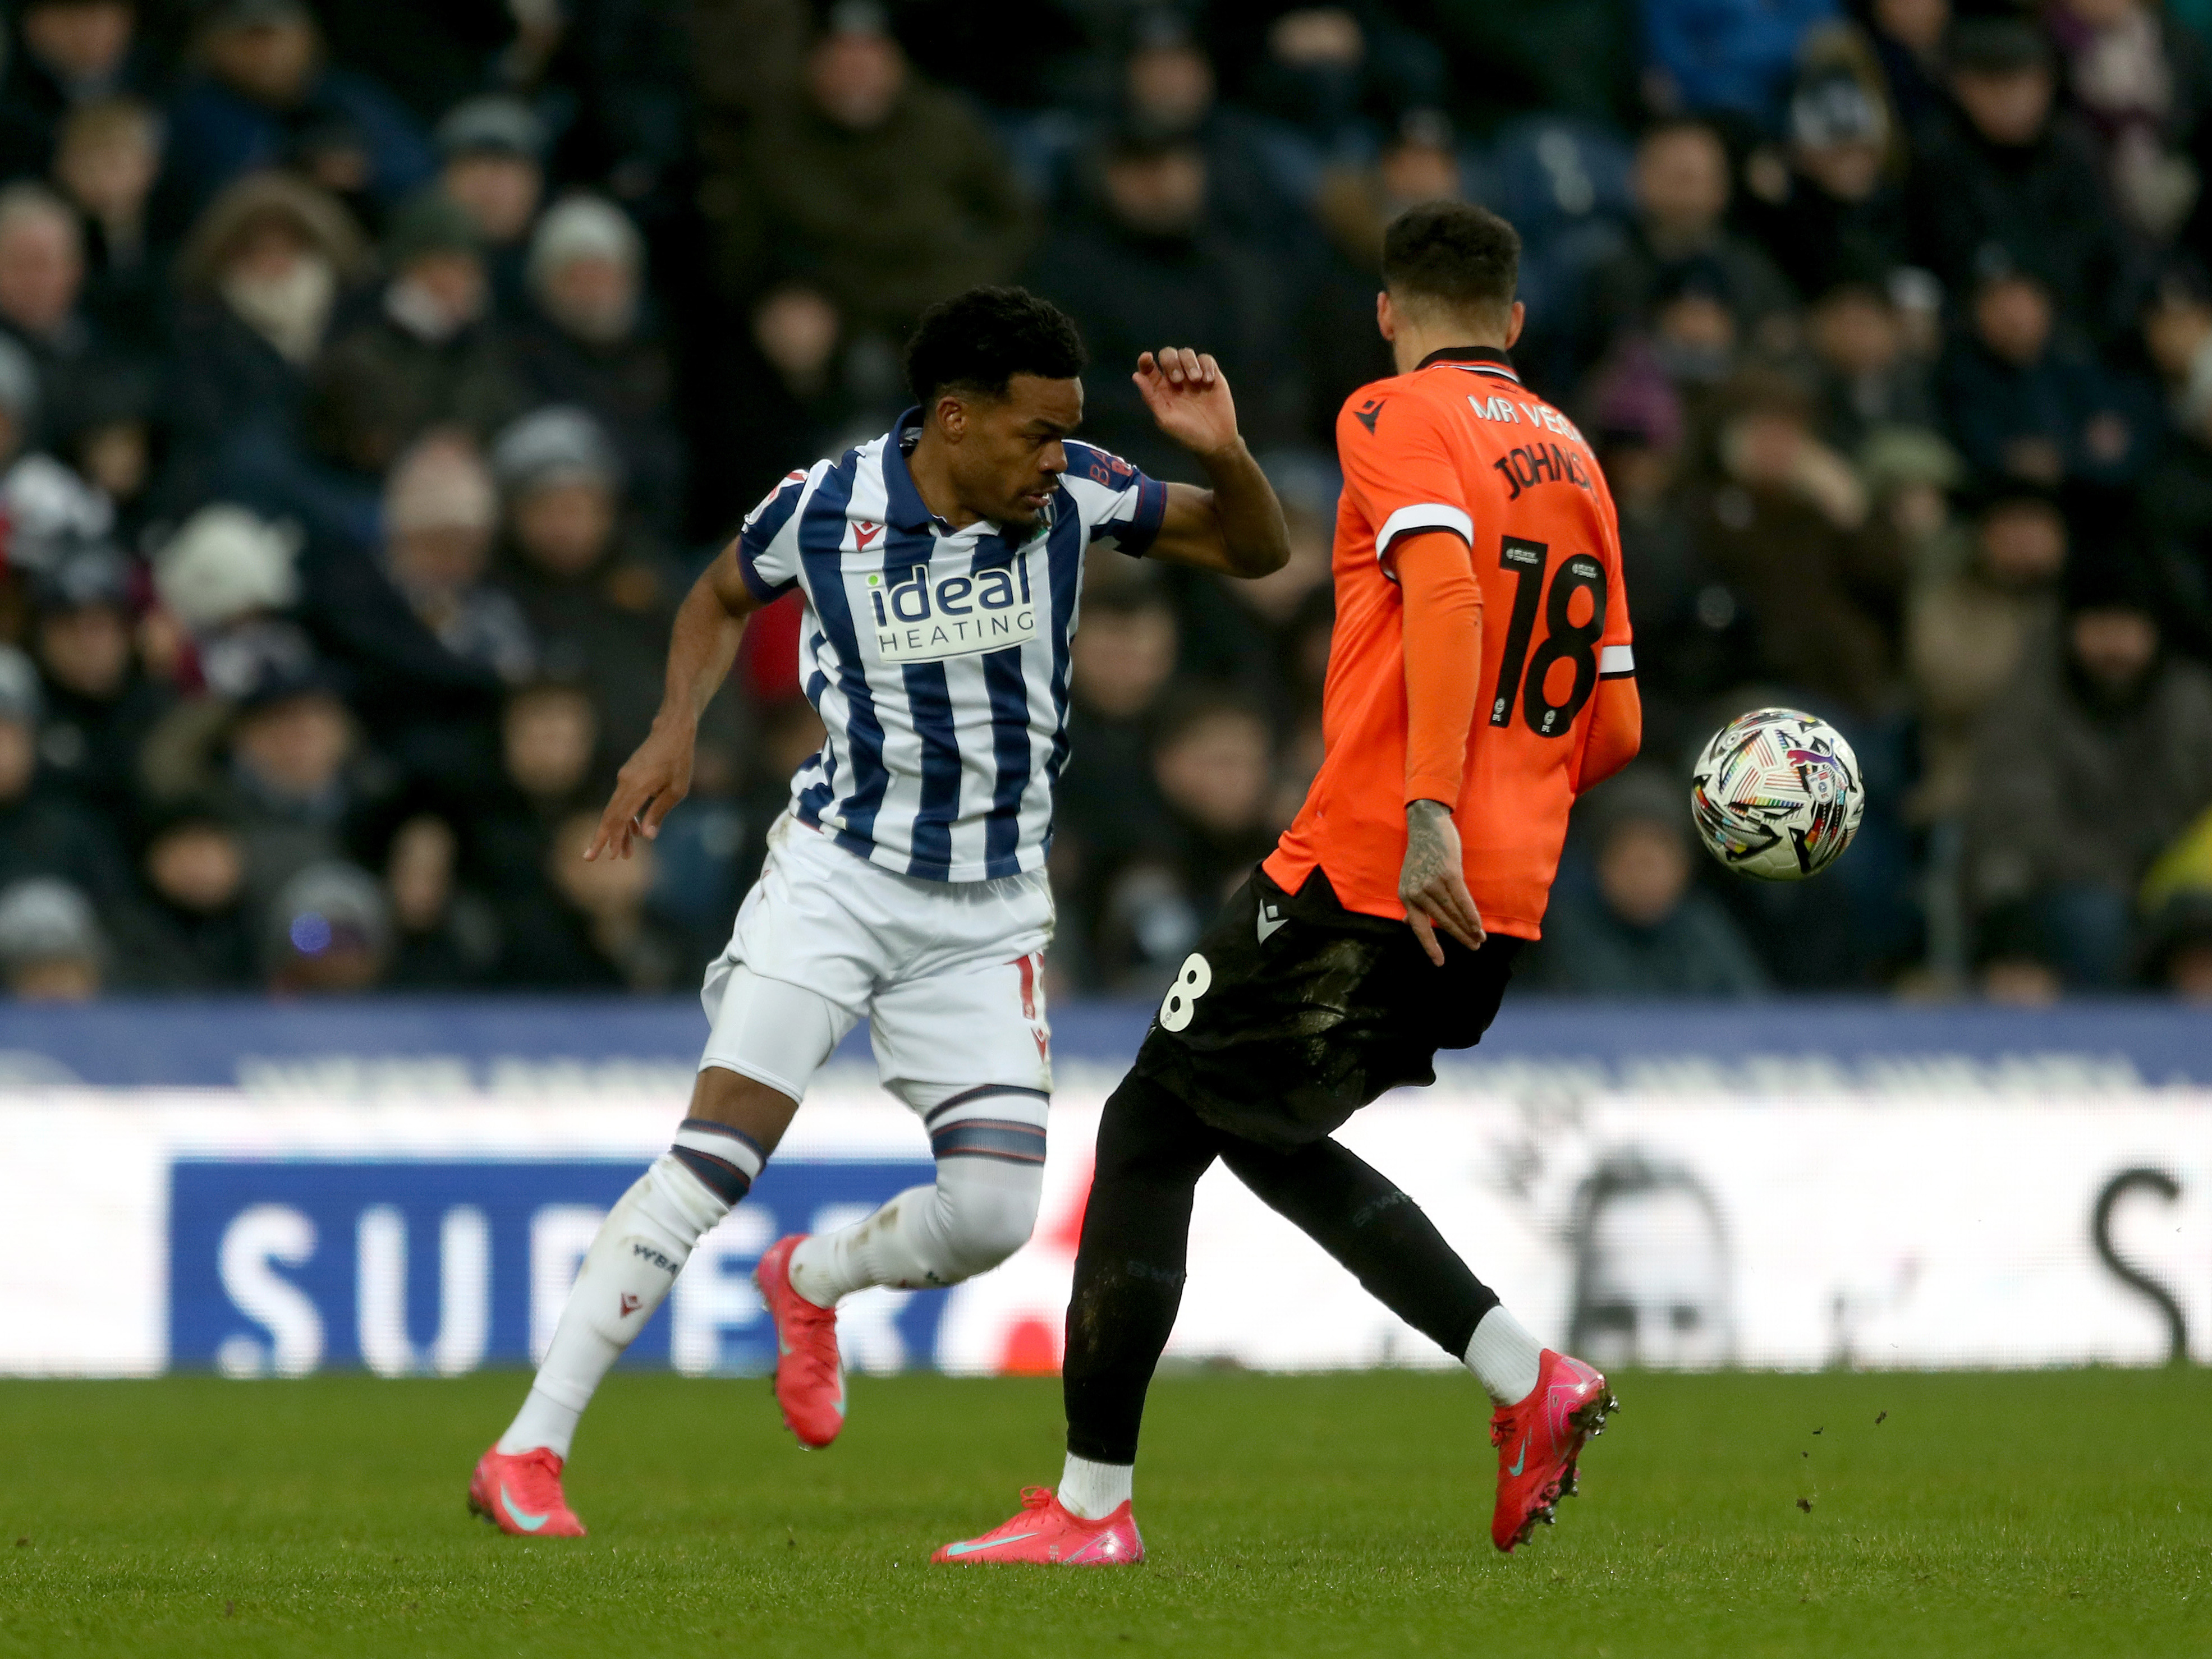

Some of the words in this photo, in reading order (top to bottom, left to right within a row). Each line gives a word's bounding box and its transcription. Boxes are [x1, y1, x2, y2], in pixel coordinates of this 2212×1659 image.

[1467, 395, 1520, 424] MR
[1494, 443, 1598, 503] JOHNS
[867, 553, 1030, 627] ideal
[879, 612, 1034, 653] HEATING
[1489, 535, 1607, 738] 18
[1159, 952, 1211, 1032] 8
[633, 1244, 678, 1276] WBA
